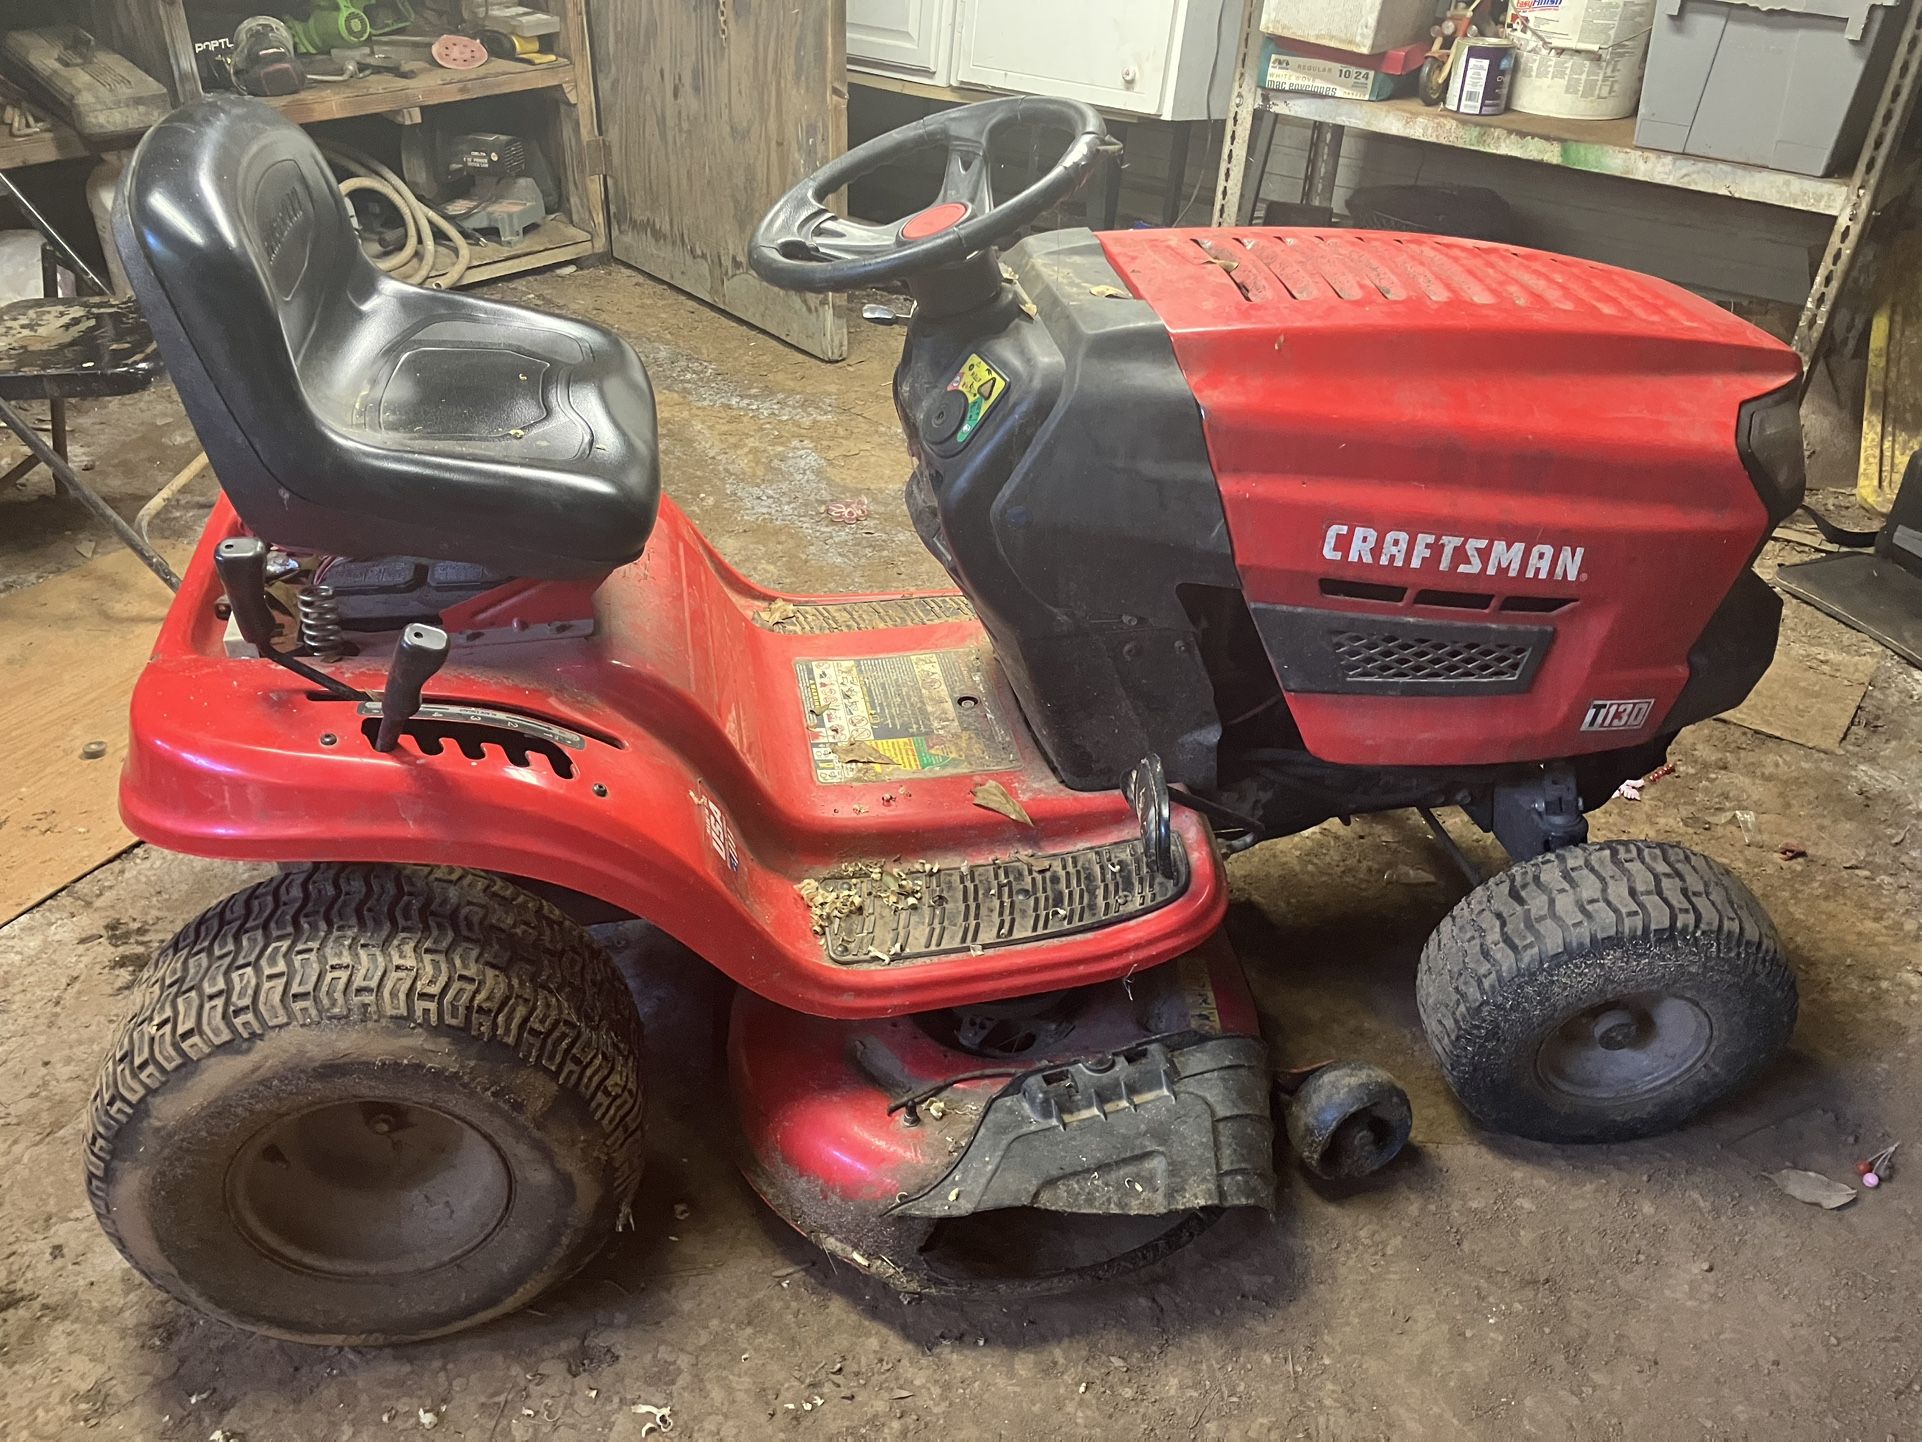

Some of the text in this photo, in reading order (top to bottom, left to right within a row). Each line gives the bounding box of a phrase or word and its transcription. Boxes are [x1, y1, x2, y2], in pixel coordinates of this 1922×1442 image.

[1298, 64, 1332, 73] REGULAR
[1269, 72, 1292, 80] WHITE
[1353, 71, 1369, 81] 24
[1267, 80, 1286, 90] mac
[1289, 81, 1337, 96] envelopes
[1322, 524, 1585, 581] CRAFTSMAN
[1586, 702, 1650, 728] T130
